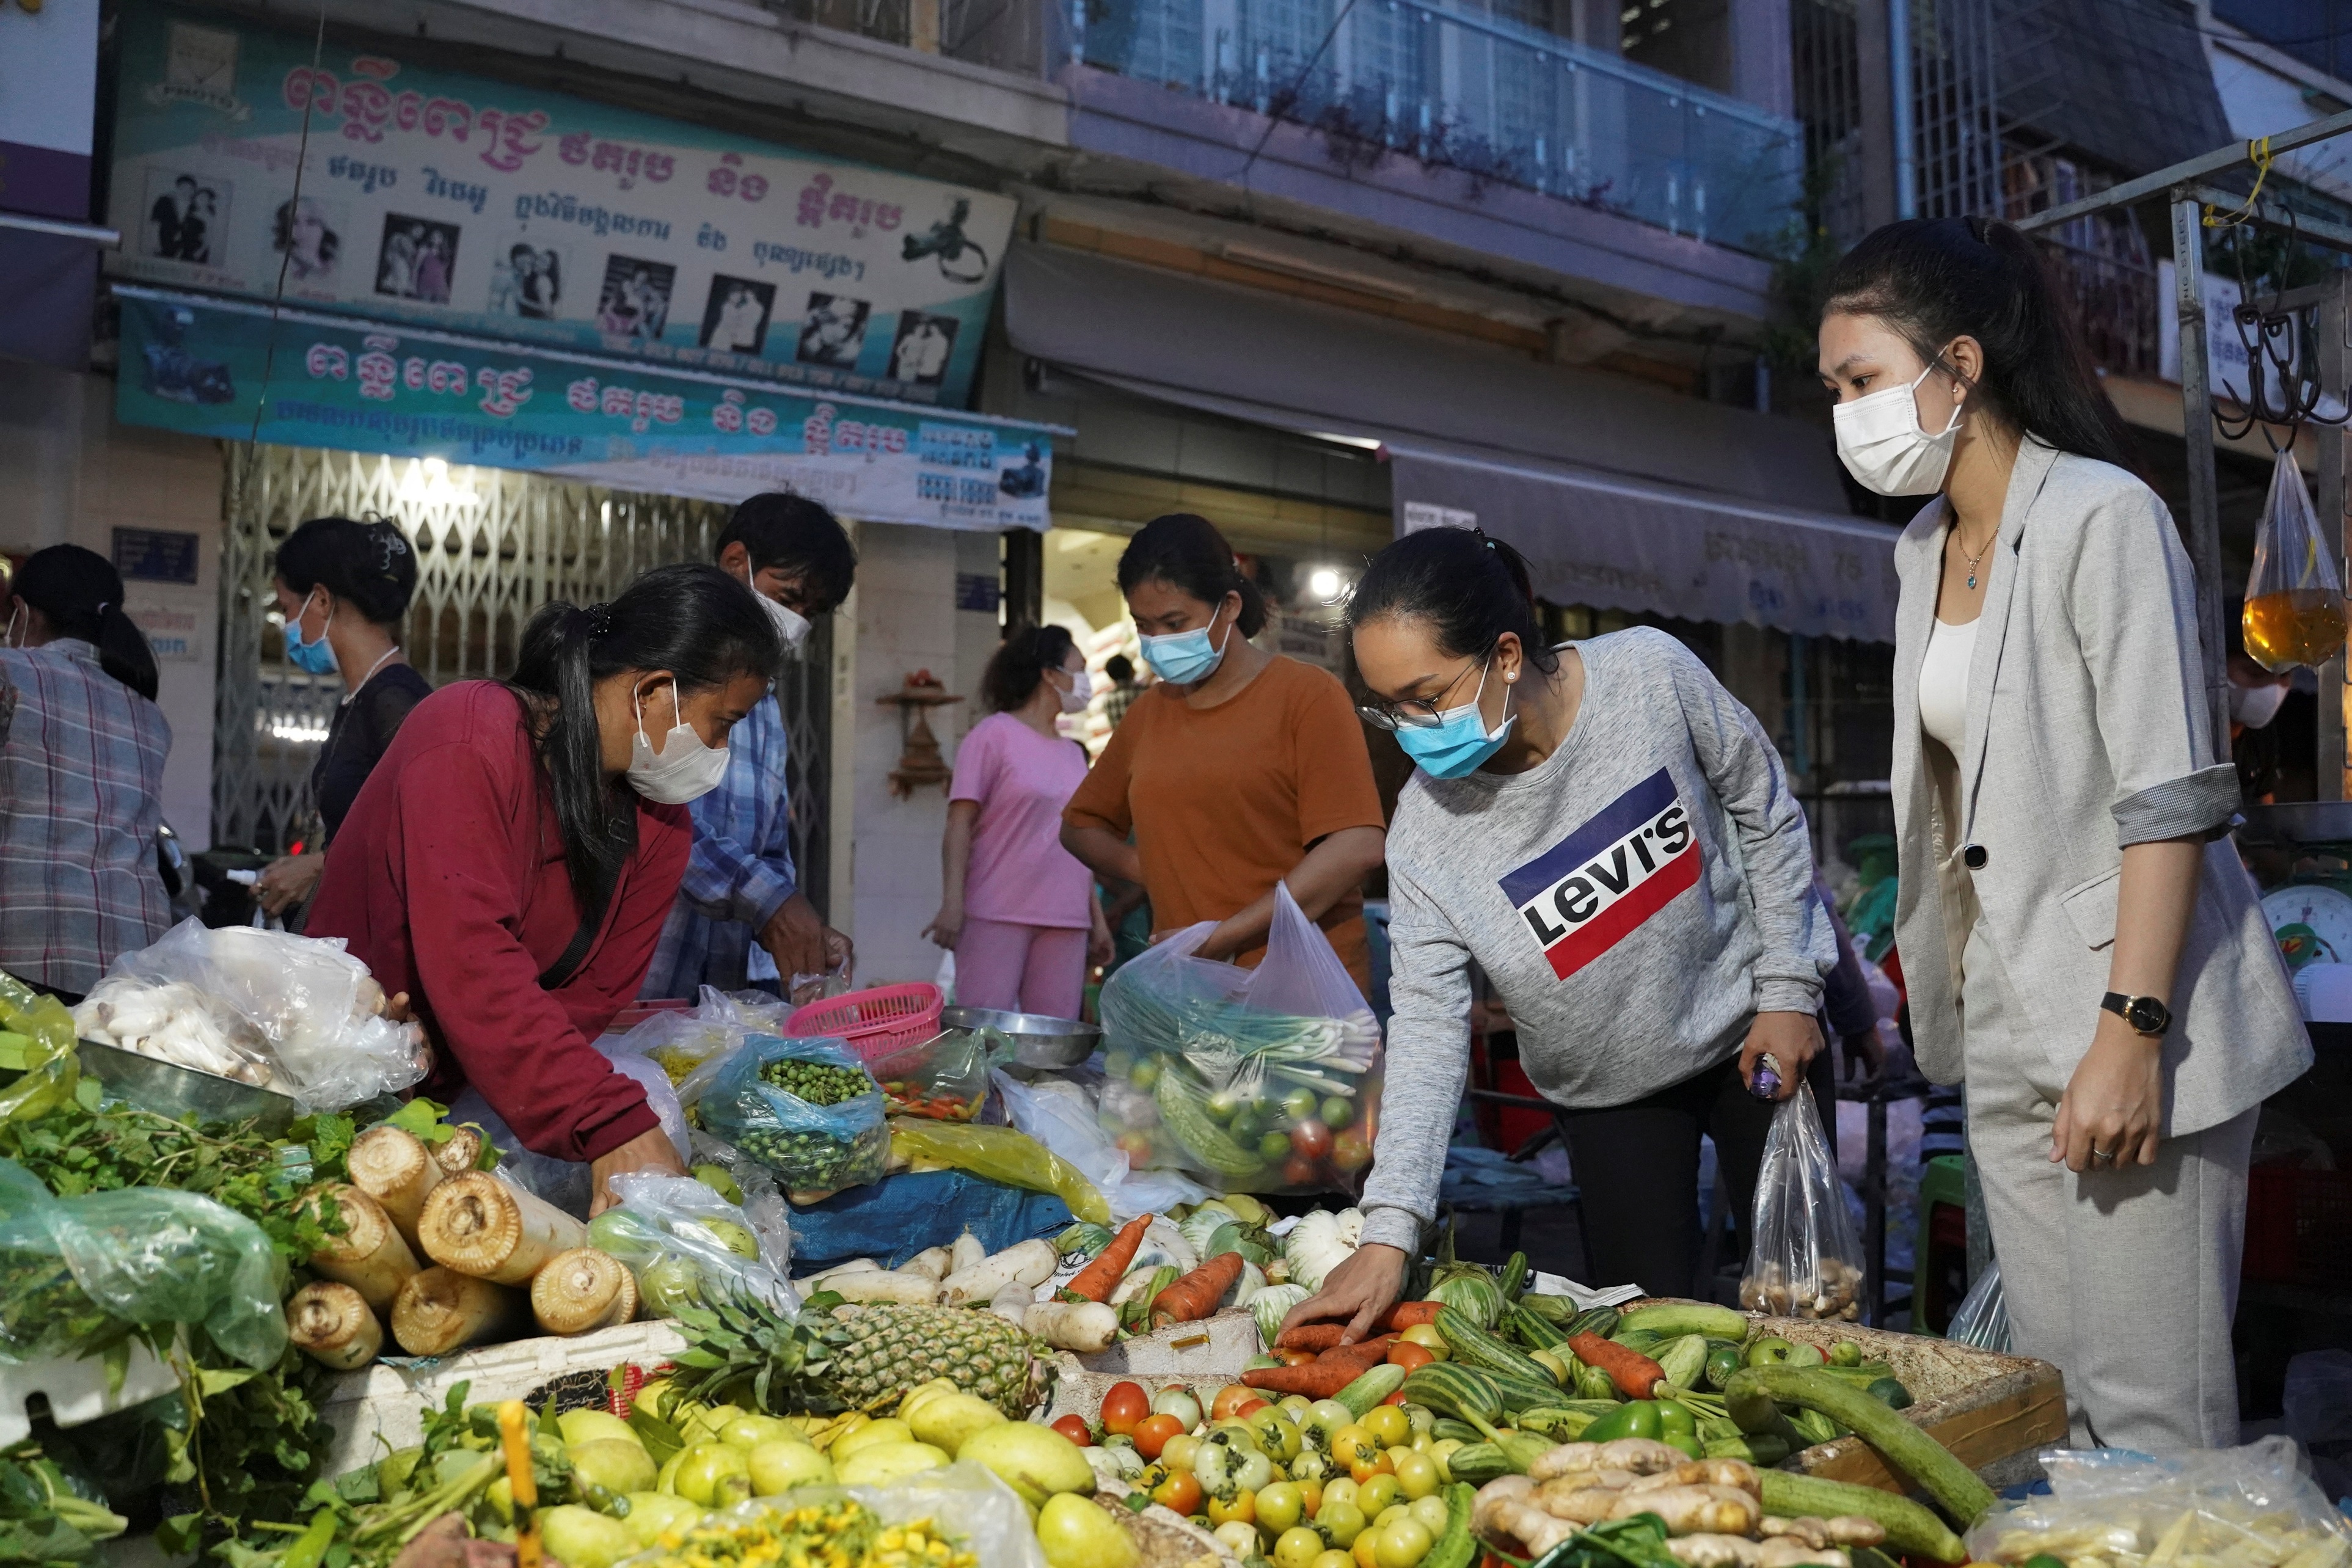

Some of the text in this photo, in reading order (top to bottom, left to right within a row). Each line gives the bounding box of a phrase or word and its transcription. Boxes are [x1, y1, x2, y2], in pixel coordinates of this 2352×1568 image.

[707, 152, 769, 202] និង
[714, 388, 777, 436] និង
[1441, 722, 1466, 734] SAIGON
